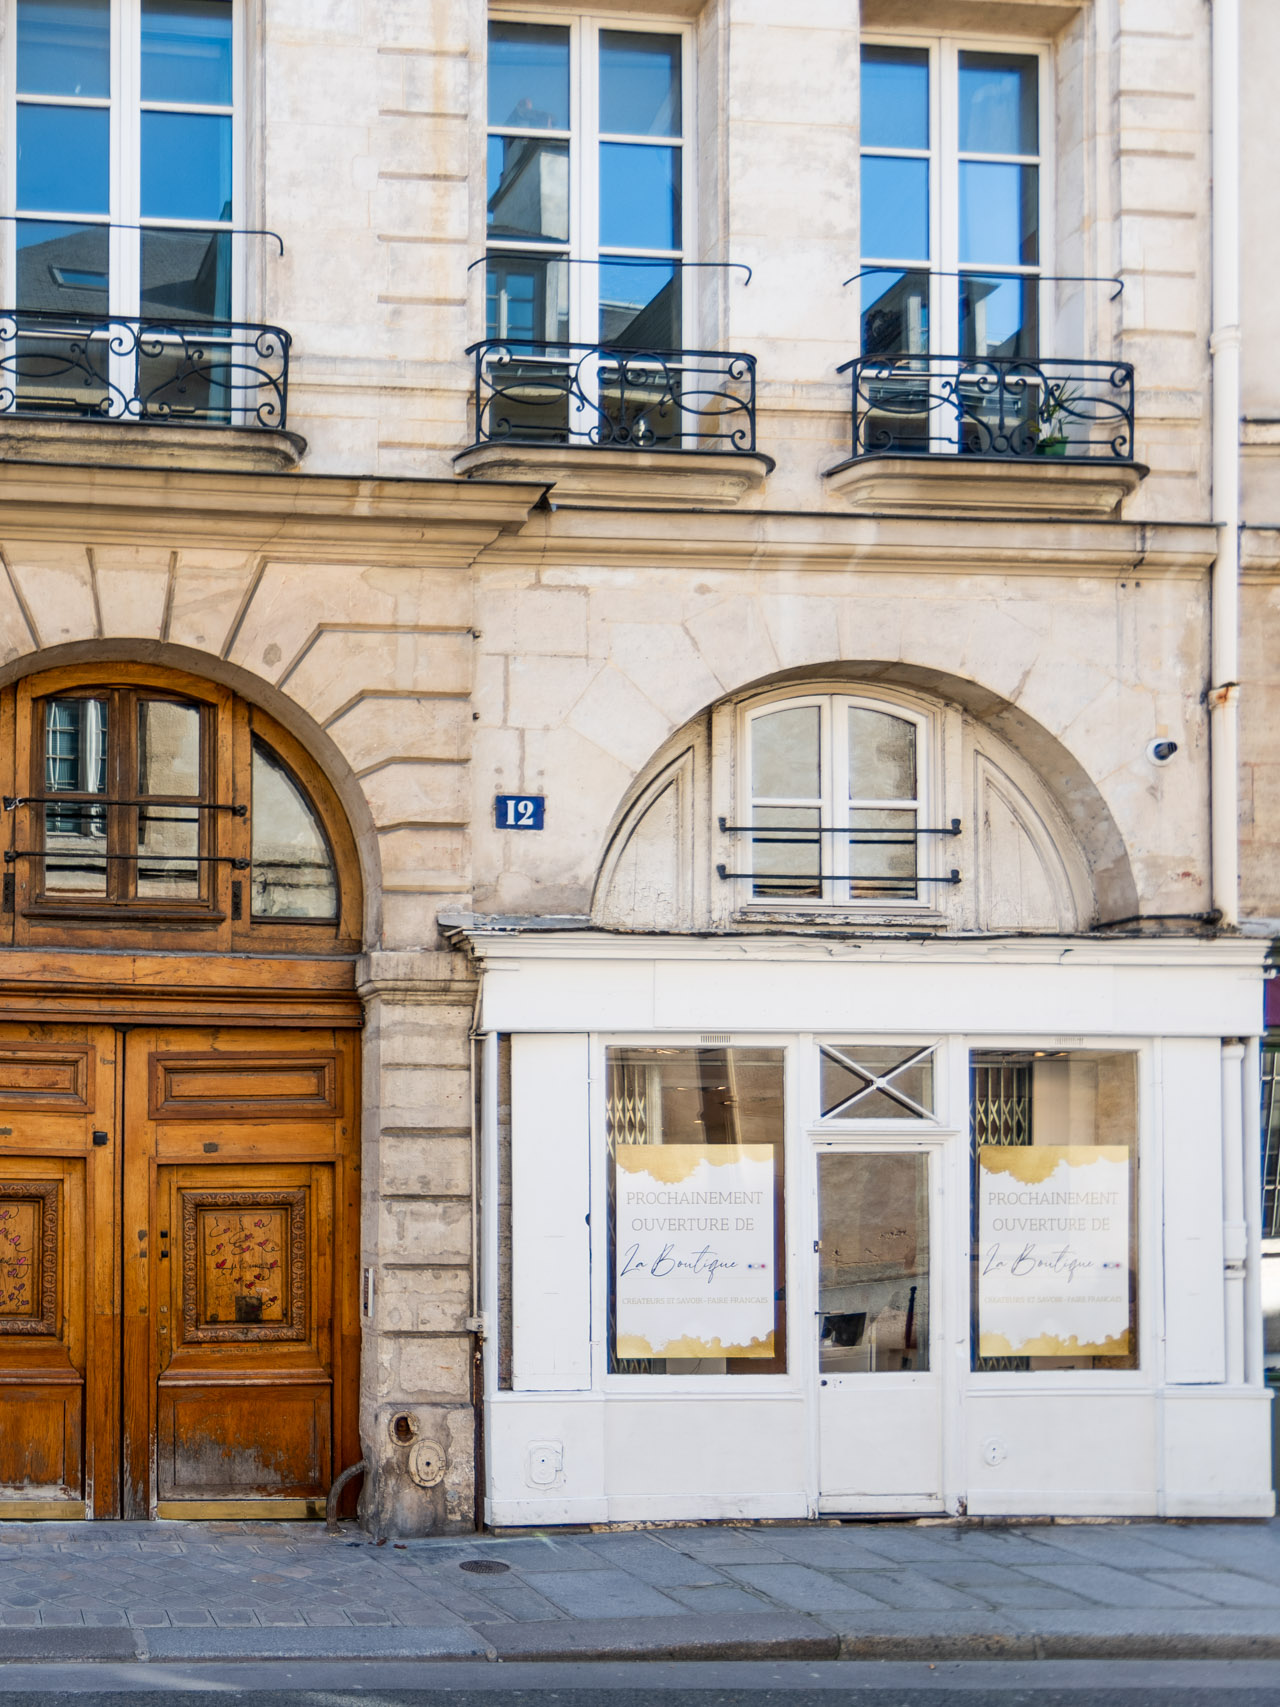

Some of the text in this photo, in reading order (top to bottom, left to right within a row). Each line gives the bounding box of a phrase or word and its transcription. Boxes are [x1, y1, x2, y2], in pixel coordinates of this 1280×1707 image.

[506, 800, 534, 825] 12
[626, 1191, 763, 1205] PROCHAINEMENT
[988, 1192, 1120, 1205] PROCHAINEMENT
[631, 1218, 754, 1231] OUVERTURE DE
[992, 1218, 1111, 1232] OUVERTURE DE
[620, 1243, 738, 1284] La Boutique
[983, 1243, 1094, 1283] La Boutique
